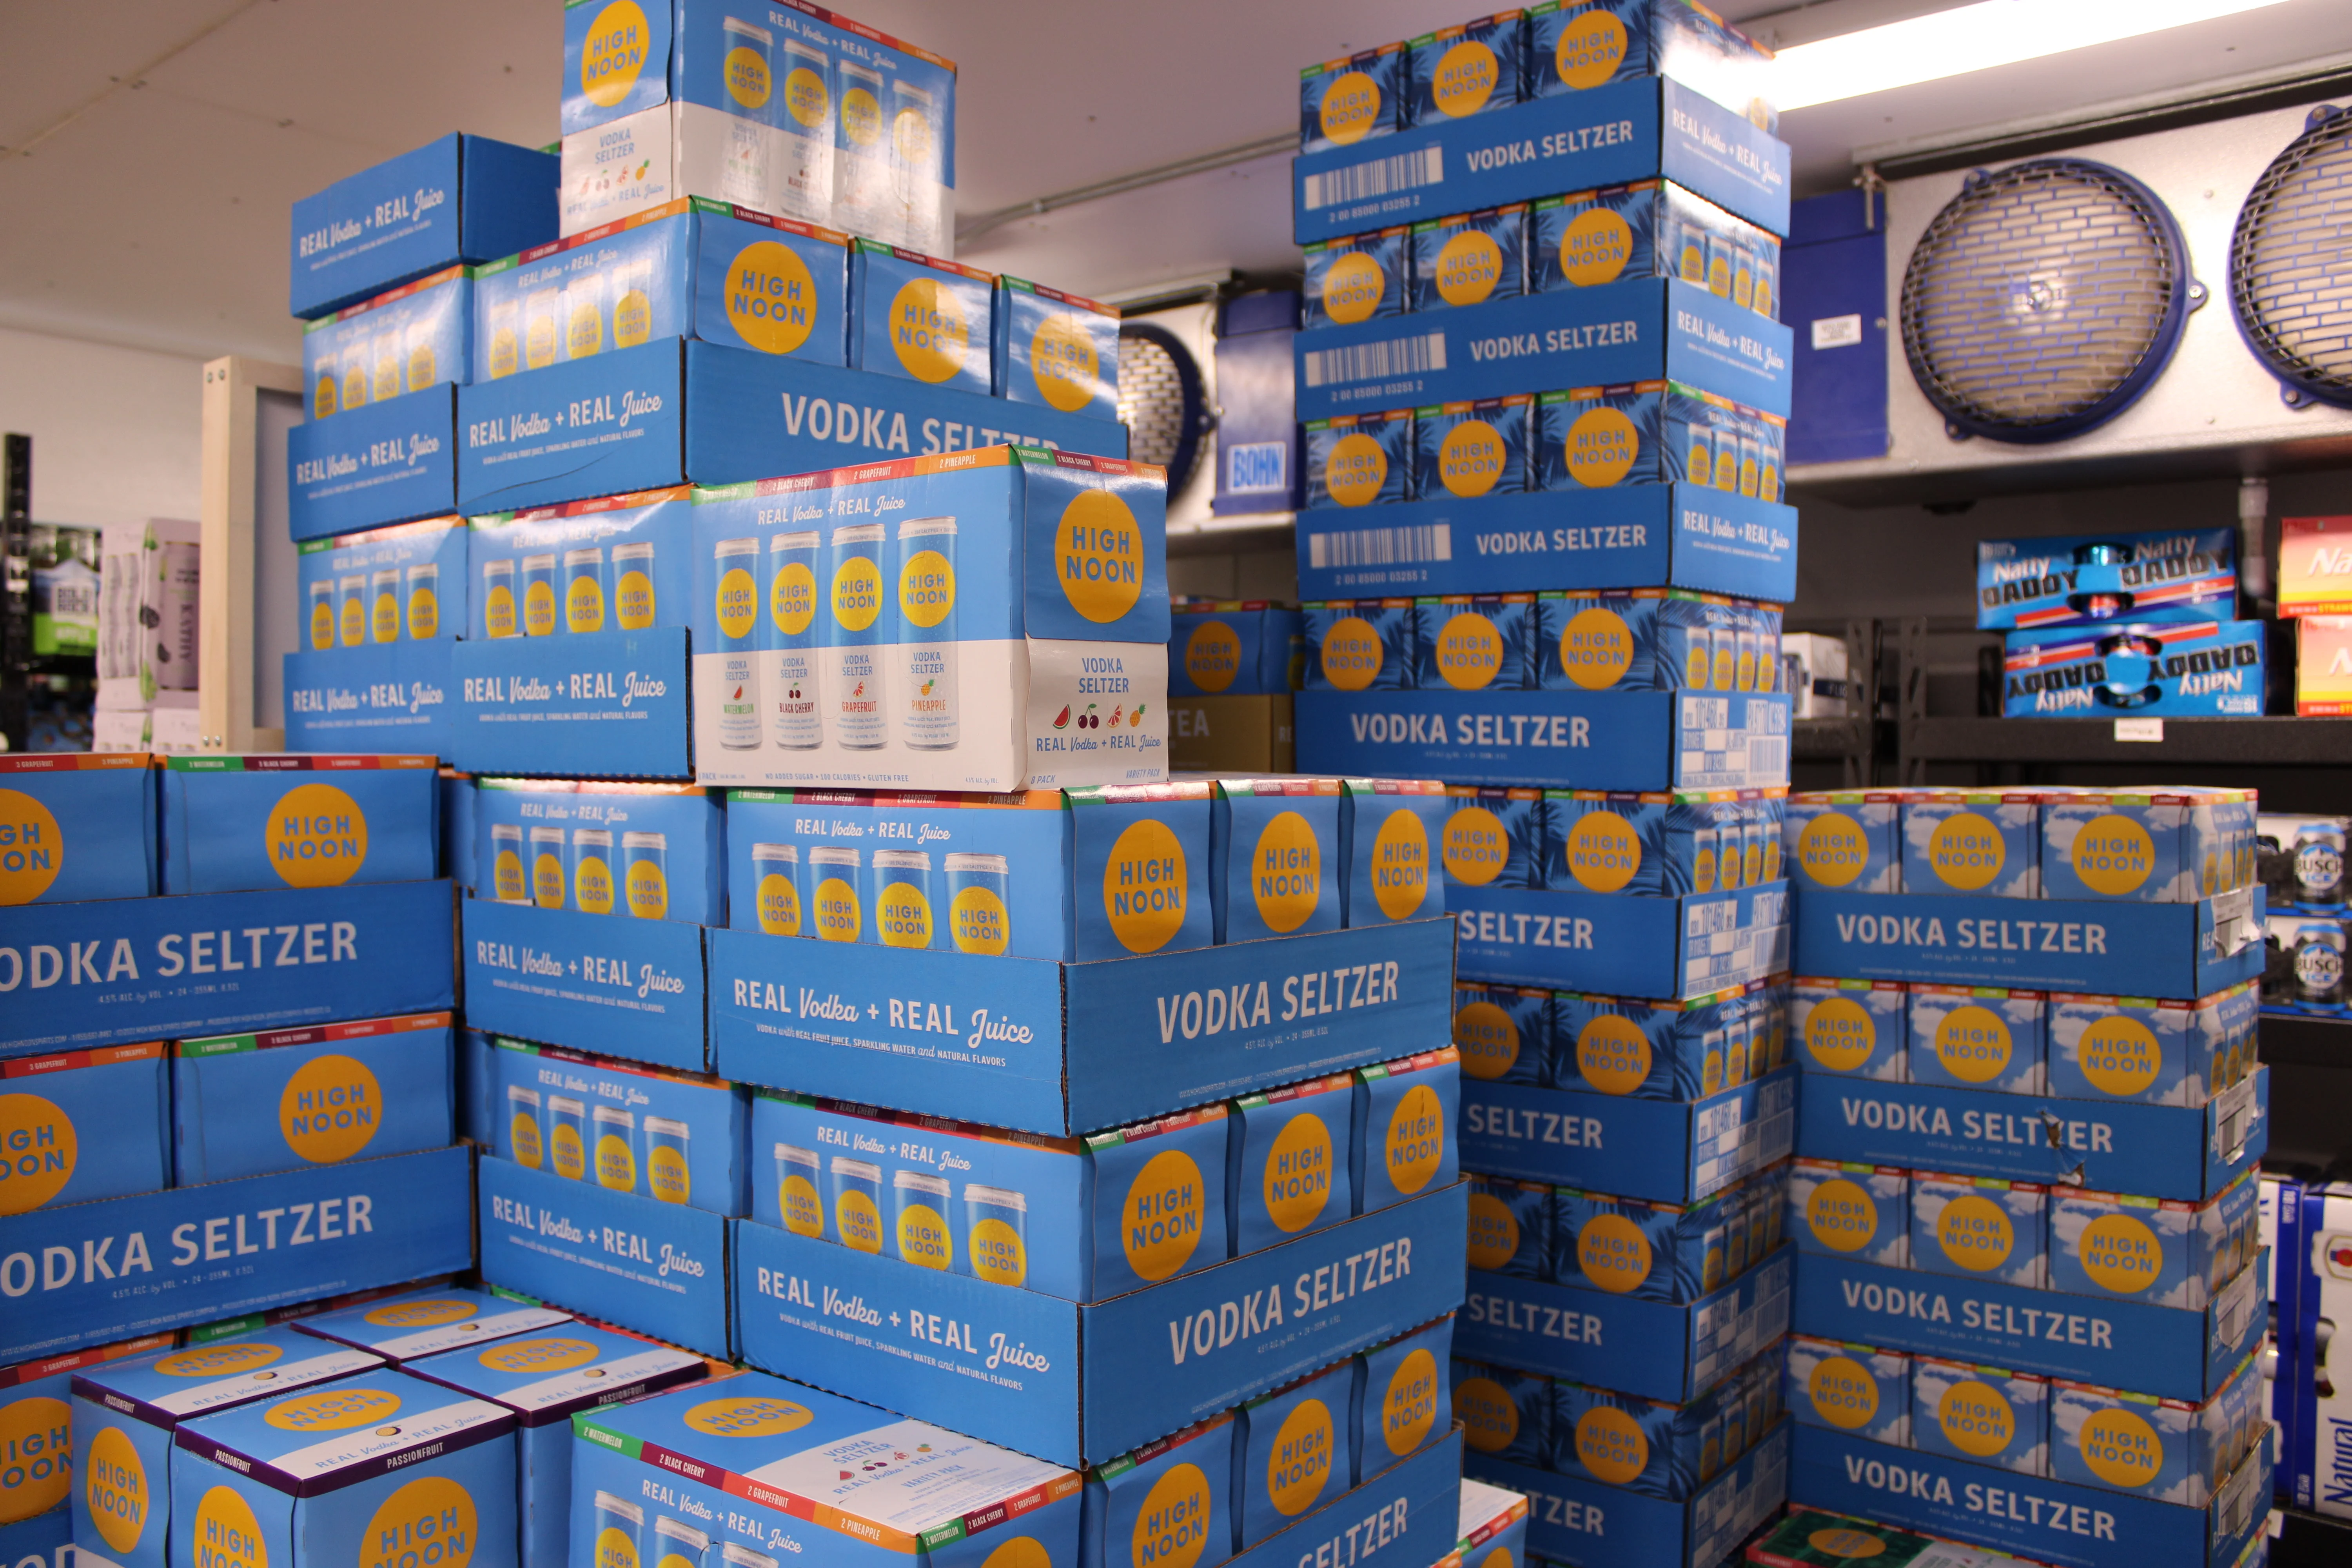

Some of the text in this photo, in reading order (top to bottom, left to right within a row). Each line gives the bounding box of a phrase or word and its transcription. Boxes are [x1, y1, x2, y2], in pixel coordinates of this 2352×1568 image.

[593, 24, 638, 58] HIGH
[1568, 28, 1615, 54] HIGH
[587, 46, 641, 81] NOON
[1563, 45, 1620, 73] NOON
[600, 129, 631, 147] VODKA
[1466, 120, 1633, 172] VODKA SELTZER
[595, 143, 635, 163] SELTZER
[741, 269, 802, 300] HIGH
[733, 292, 807, 326] NOON
[782, 393, 910, 452] VODKA
[940, 455, 975, 468] 2 PINEAPPLE
[1022, 448, 1049, 460] WATERMELON
[1062, 455, 1076, 464] BLACK
[1077, 457, 1091, 466] CHERRY
[854, 466, 892, 480] 2 GRAPEFRUIT
[1234, 448, 1281, 487] BOHN
[758, 508, 788, 525] REAL
[793, 506, 824, 522] Vodka
[838, 499, 870, 515] REAL
[874, 495, 905, 517] Juice
[1073, 526, 1129, 554] HIGH
[1475, 525, 1646, 555] VODKA SELTZER
[2134, 535, 2196, 562] Natty
[909, 573, 945, 588] HIGH
[1067, 556, 1135, 584] NOON
[1993, 557, 2051, 583] Natty
[907, 590, 947, 604] NOON
[913, 652, 941, 661] VODKA
[1194, 643, 1232, 655] HIGH
[911, 663, 944, 674] SELTZER
[1082, 658, 1123, 673] VODKA
[1191, 659, 1234, 671] NOON
[464, 677, 505, 702] REAL
[509, 677, 551, 704] Vodka
[570, 673, 617, 699] REAL
[623, 671, 666, 706] Juice
[1078, 677, 1129, 693] SELTZER
[2179, 669, 2243, 695] Natty
[724, 703, 754, 715] WATERMELON
[780, 702, 814, 714] BLACK CHERRY
[842, 701, 877, 713] GRAPEFRUIT
[912, 699, 946, 711] PINEAPPLE
[1351, 713, 1590, 748] VODKA SELTZER
[1036, 737, 1066, 752] REAL
[1070, 737, 1098, 751] Vodka
[1110, 735, 1136, 749] REAL
[1139, 734, 1161, 752] Juice
[22, 760, 54, 768] GRAPEFRUIT
[1126, 768, 1161, 779] VARIETY PACK
[1037, 775, 1055, 784] PACK
[284, 815, 350, 837] HIGH
[278, 839, 358, 862] NOON
[1580, 835, 1628, 852] HIGH
[2086, 837, 2140, 854] HIGH
[1120, 858, 1174, 885] HIGH
[1575, 851, 1632, 870] NOON
[2080, 855, 2145, 872] NOON
[1114, 887, 1180, 916] NOON
[1459, 909, 1594, 950] SELTZER
[1837, 913, 2107, 955] VODKA SELTZER
[158, 921, 357, 978] SELTZER
[734, 979, 791, 1013] REAL
[799, 987, 859, 1022] Vodka
[889, 999, 958, 1035] REAL
[967, 1009, 1034, 1049] Juice
[1157, 960, 1399, 1044] VODKA SELTZER
[757, 1024, 1006, 1067] VODKA with REAL FRUIT JUICE, SPARKLING WATER and NATURAL FLAVORS
[1138, 1183, 1192, 1220] HIGH
[172, 1195, 373, 1267] SELTZER
[1132, 1210, 1197, 1250] NOON
[1468, 1293, 1603, 1347] SELTZER
[1842, 1279, 2113, 1350] VODKA SELTZER
[105, 1394, 135, 1412] PASSIONFRUIT
[584, 1428, 623, 1448] 2 WATERMELON
[823, 1439, 876, 1458] VODKA
[215, 1449, 251, 1473] PASSIONFRUIT
[387, 1443, 443, 1468] PASSIONFRUIT
[833, 1442, 895, 1465] SELTZER
[97, 1458, 138, 1494] HIGH
[660, 1454, 706, 1478] 2 BLACK CHERRY
[901, 1464, 966, 1489] VARIETY PACK
[93, 1483, 141, 1524] NOON
[748, 1486, 789, 1508] 2 GRAPEFRUIT
[643, 1480, 675, 1507] REAL
[679, 1494, 713, 1521] Vodka
[728, 1511, 764, 1540] REAL
[767, 1529, 803, 1553] Juice
[381, 1507, 457, 1554] HIGH
[841, 1517, 881, 1541] 2 PINEAPPLE
[926, 1526, 960, 1546] 2 WATERMELON
